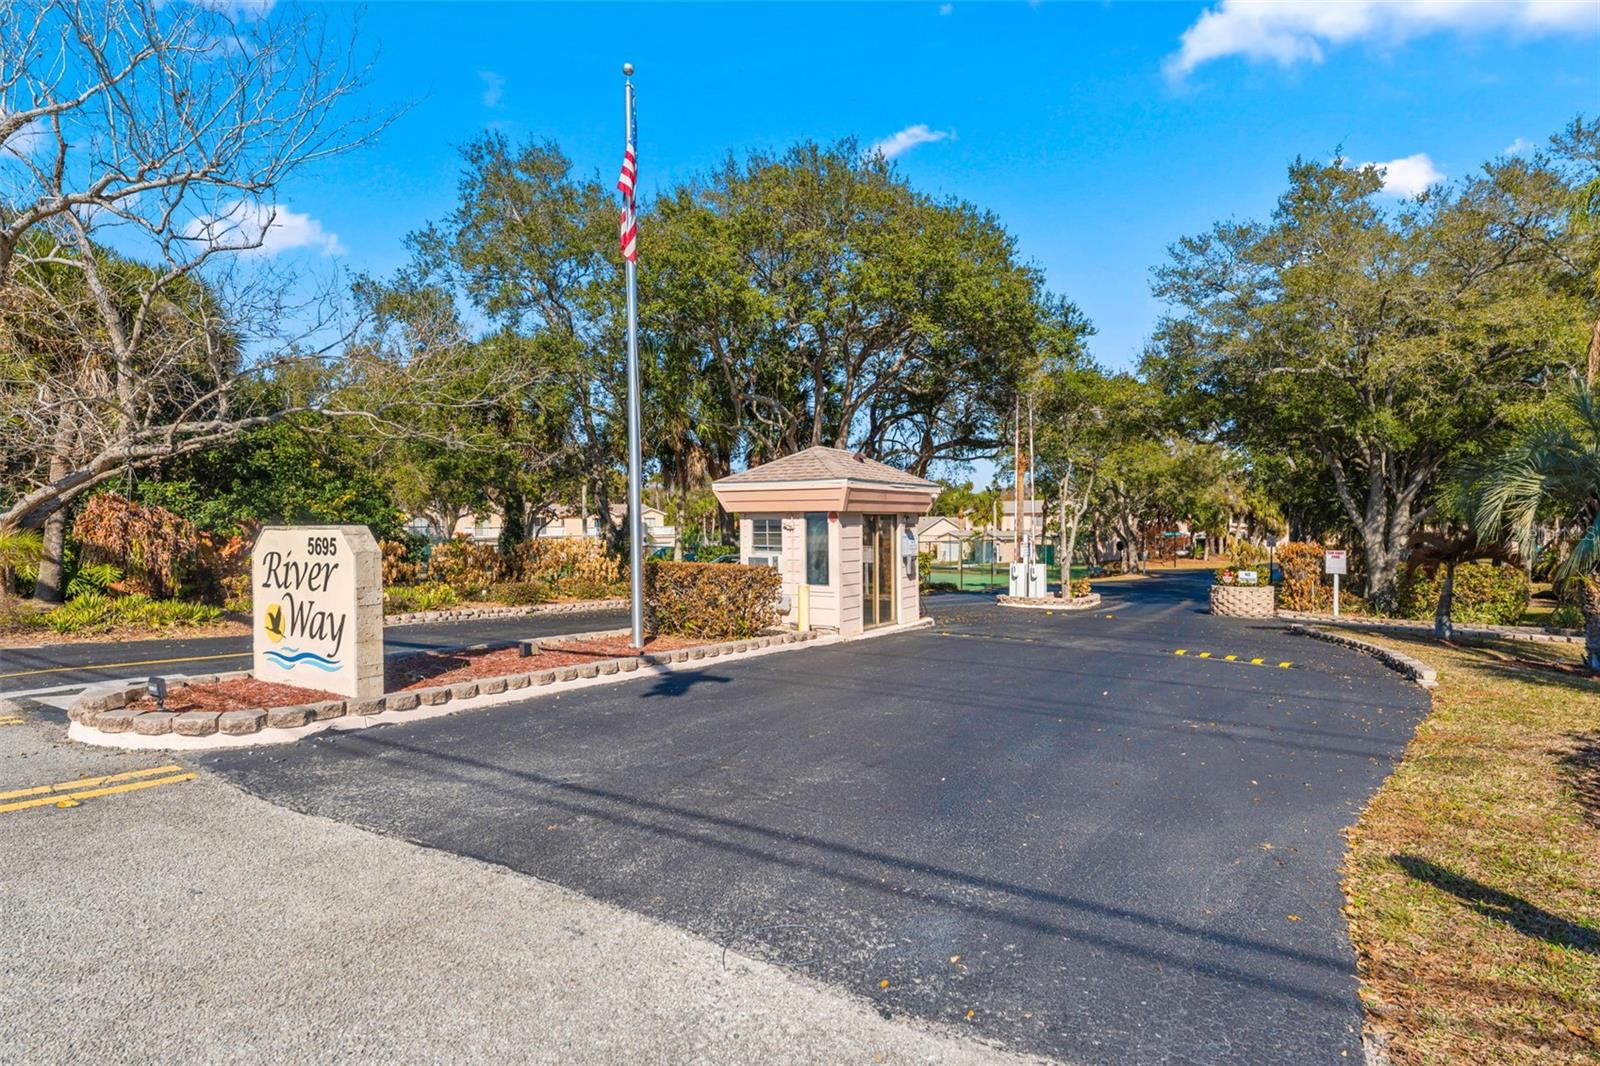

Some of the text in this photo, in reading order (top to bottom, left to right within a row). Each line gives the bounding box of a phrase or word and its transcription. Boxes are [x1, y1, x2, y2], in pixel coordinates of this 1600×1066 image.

[307, 537, 337, 556] 5695
[262, 550, 339, 592] River
[282, 592, 346, 658] Way
